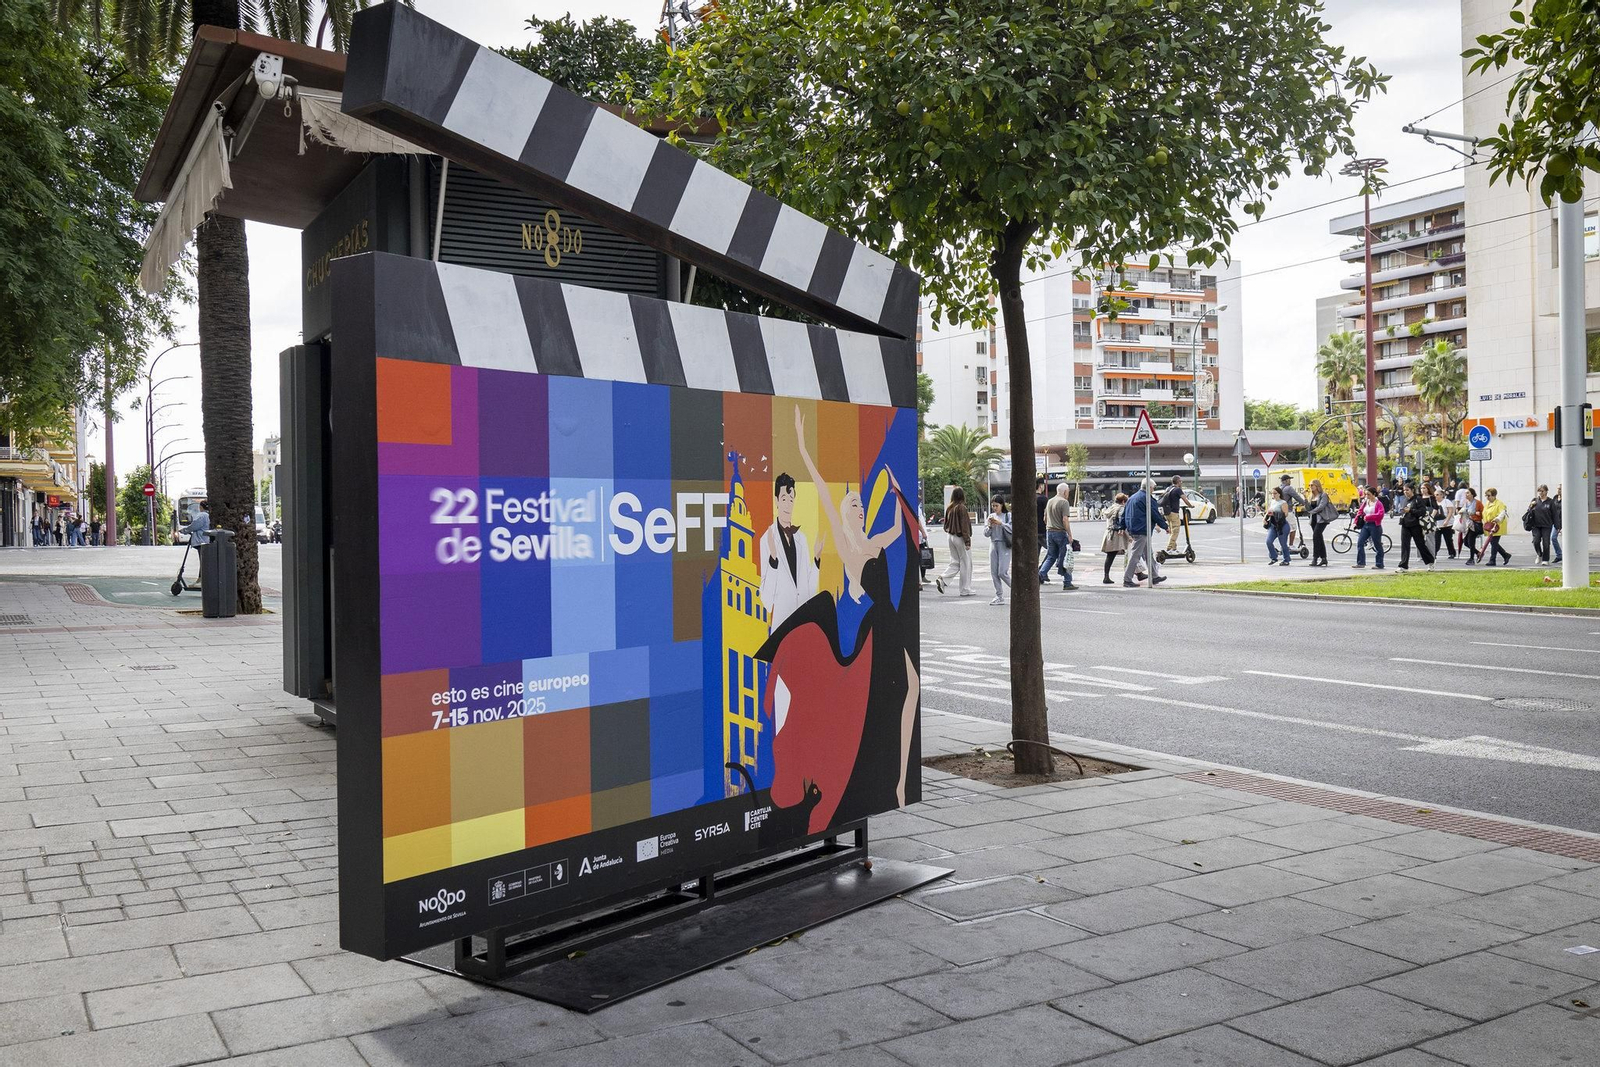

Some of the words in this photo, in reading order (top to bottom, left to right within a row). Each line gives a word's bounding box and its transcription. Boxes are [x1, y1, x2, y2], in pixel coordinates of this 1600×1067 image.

[1503, 419, 1524, 430] ING
[429, 487, 478, 524] 22
[485, 488, 596, 524] Festival
[608, 491, 730, 556] SeFF
[435, 527, 482, 565] de
[489, 525, 595, 562] Sevilla
[431, 686, 467, 706] esto
[471, 686, 490, 701] es
[493, 680, 524, 698] cine
[528, 673, 590, 693] europeo
[431, 707, 469, 730] 7-15
[473, 705, 505, 724] nov.
[507, 697, 546, 719] 2025
[750, 814, 769, 823] CENTER
[750, 821, 762, 830] CITE
[659, 832, 676, 842] Europa
[694, 822, 731, 841] SYRSA
[659, 838, 679, 848] Creativa
[592, 854, 607, 863] Junta
[592, 863, 599, 871] de
[600, 856, 623, 869] Andalucía
